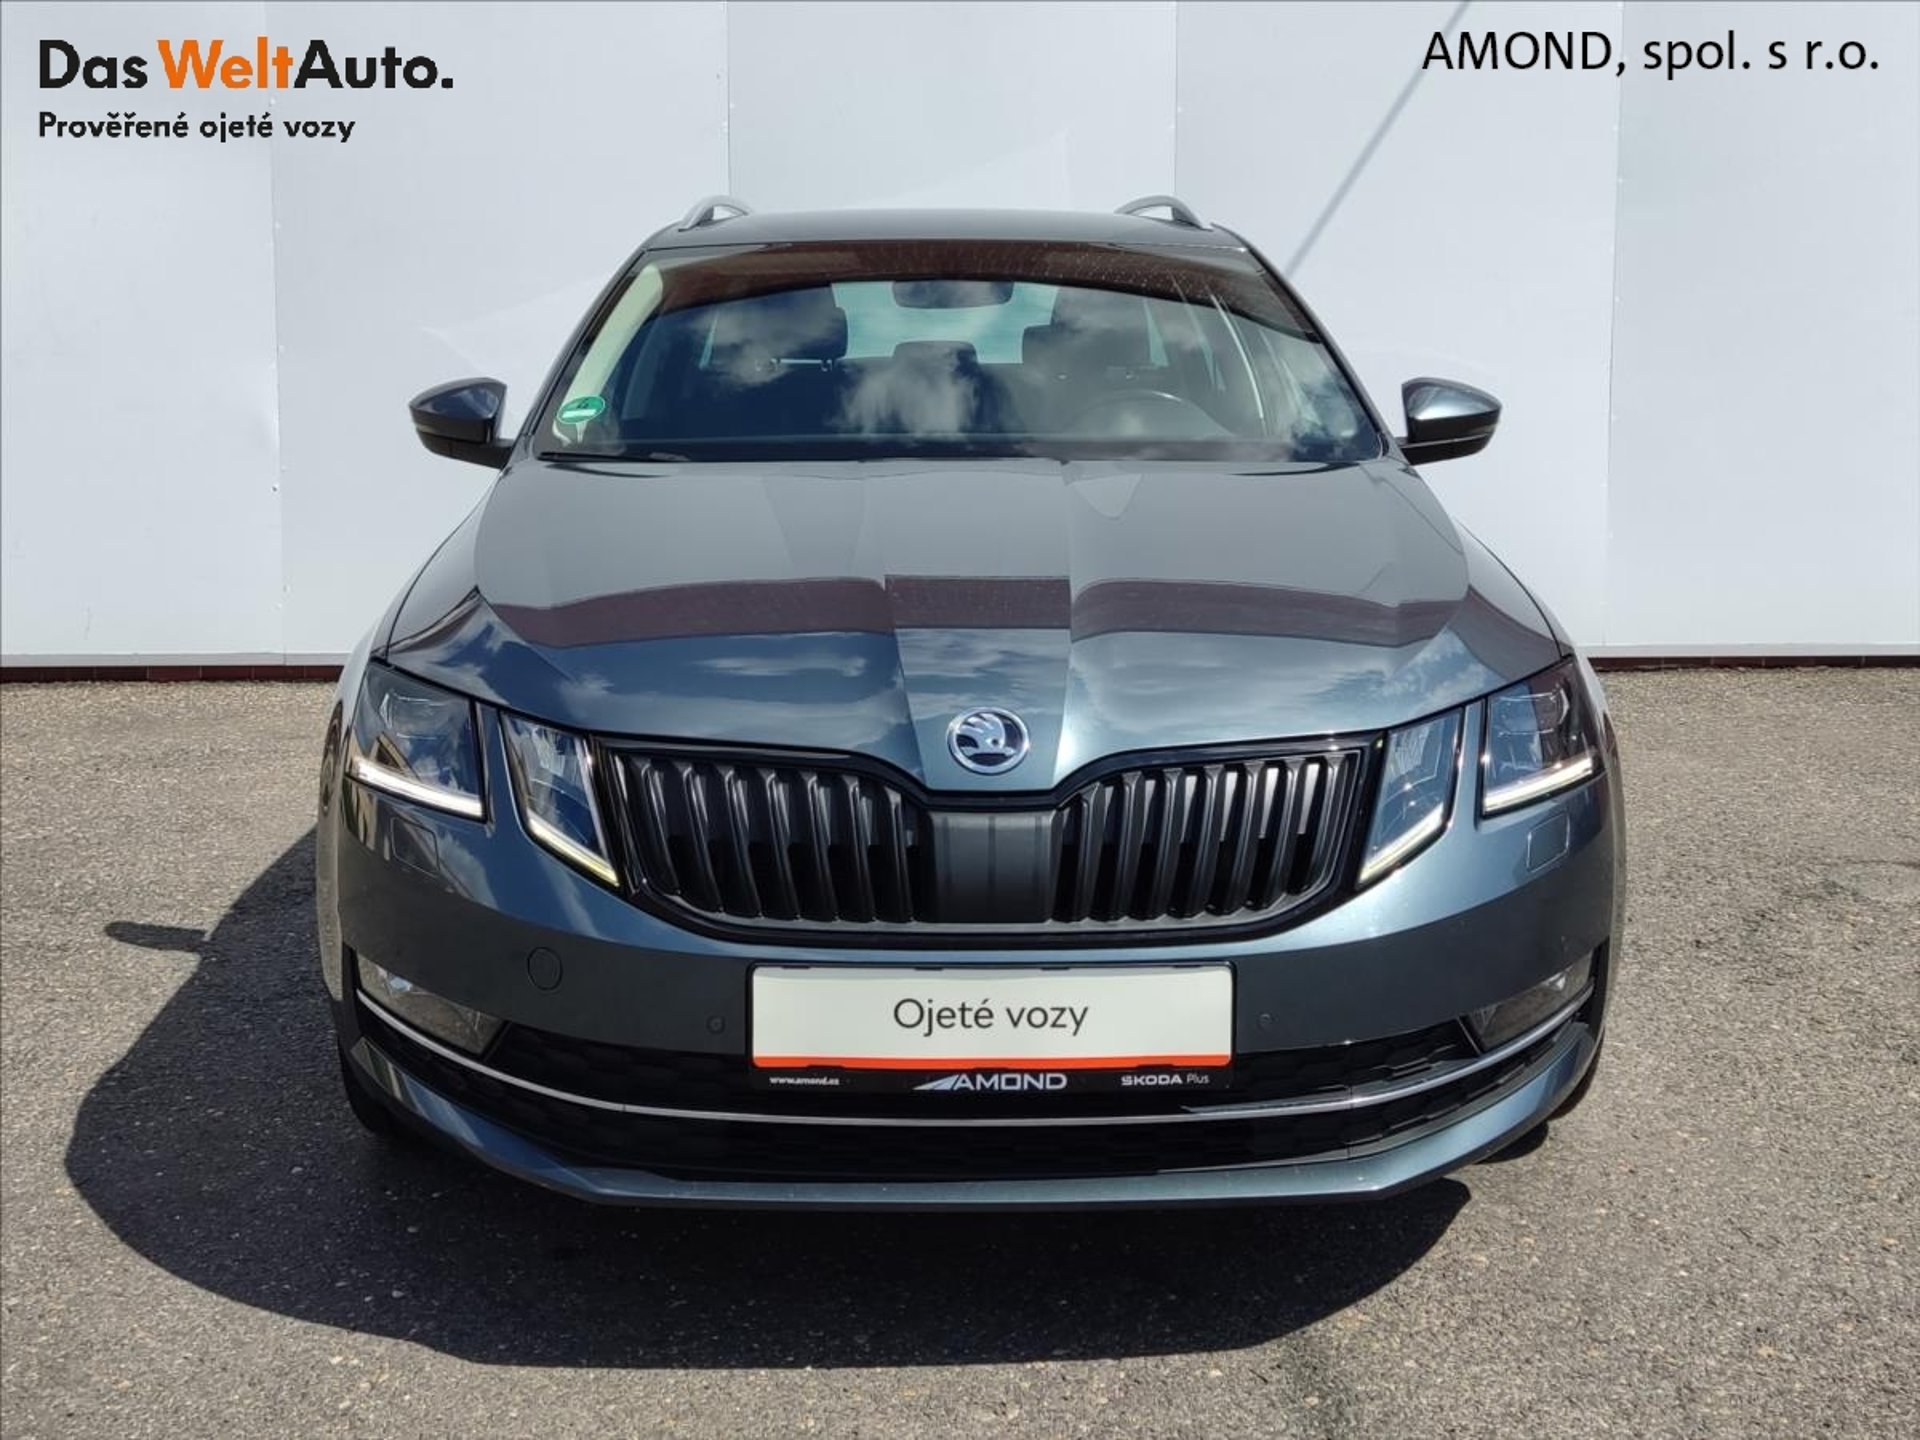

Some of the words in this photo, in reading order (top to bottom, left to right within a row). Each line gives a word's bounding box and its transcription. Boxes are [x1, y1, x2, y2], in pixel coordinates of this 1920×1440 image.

[893, 997, 995, 1037] Ojeté
[1005, 1006, 1089, 1037] vozy
[952, 1073, 1068, 1091] AMOND
[1186, 1073, 1210, 1084] Plus
